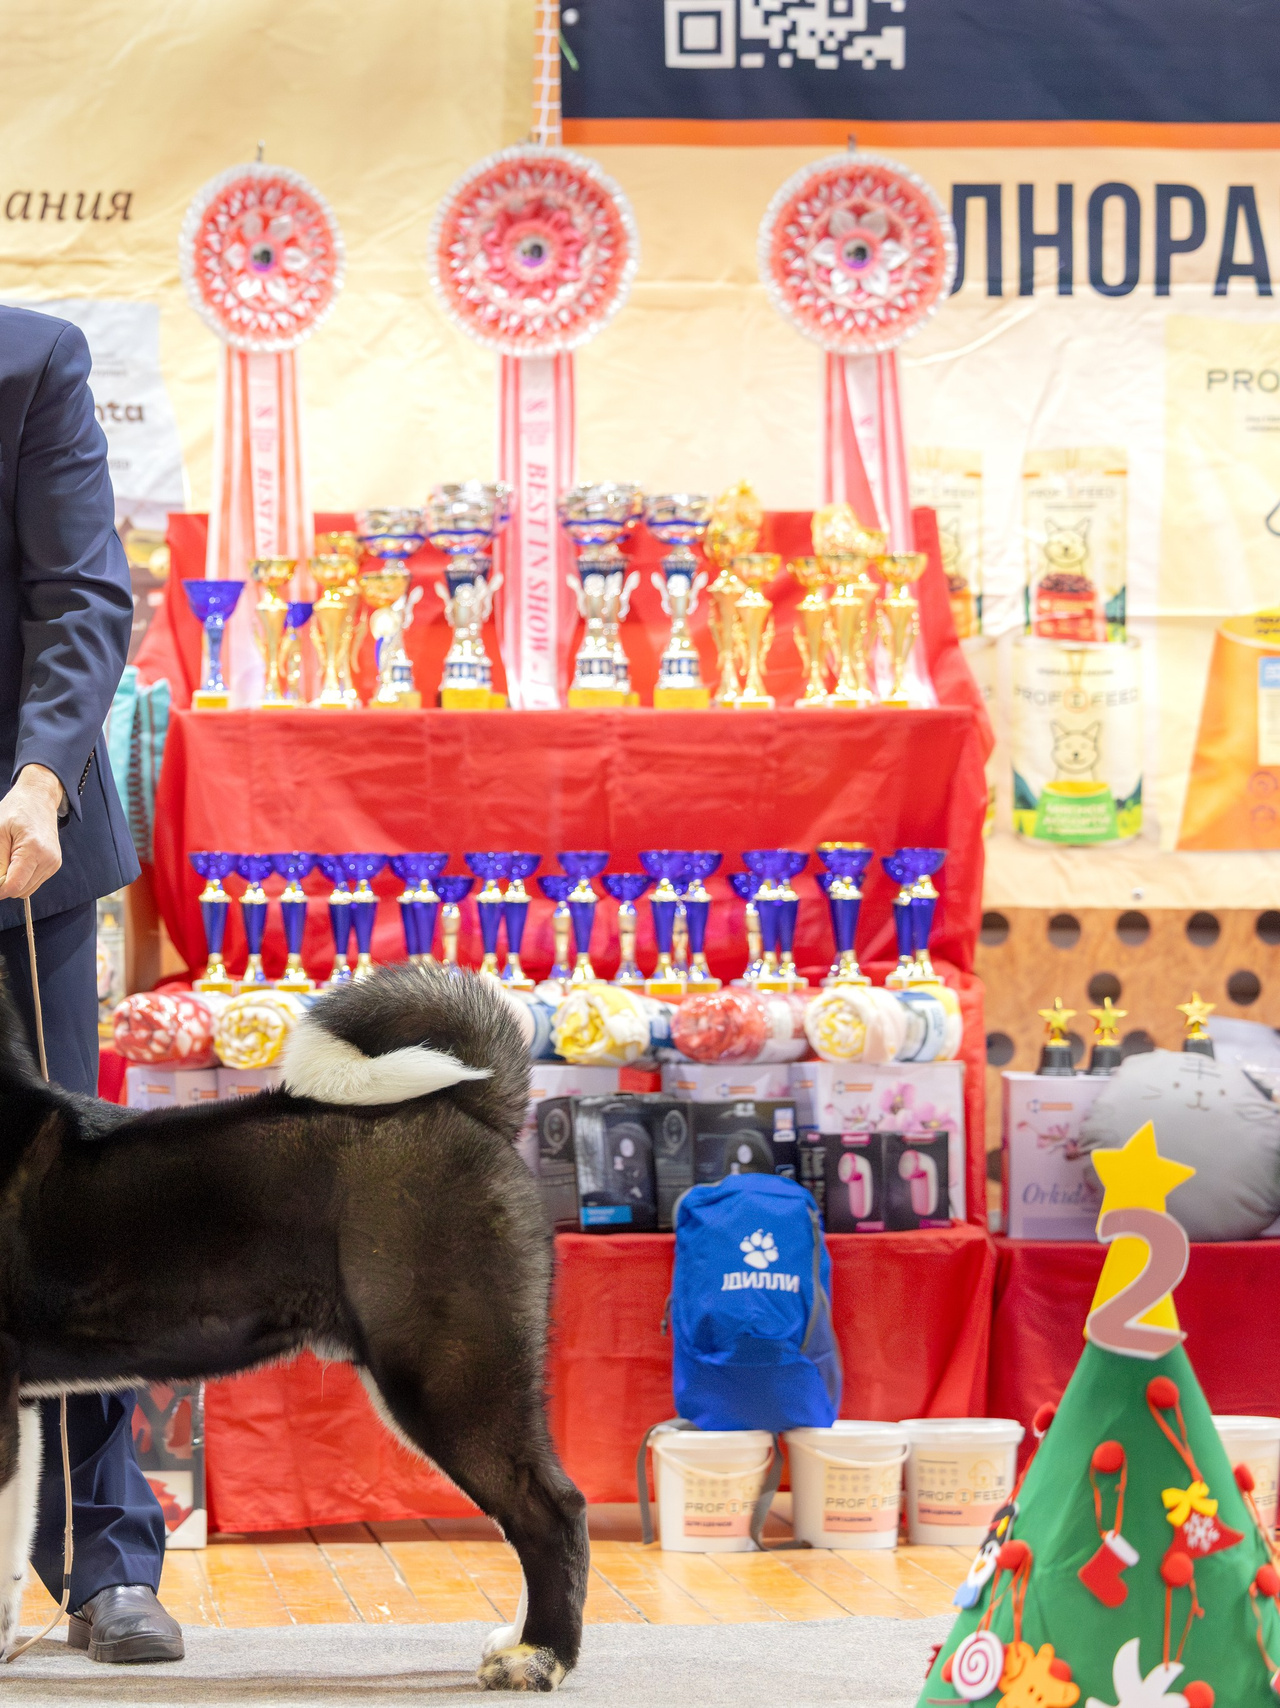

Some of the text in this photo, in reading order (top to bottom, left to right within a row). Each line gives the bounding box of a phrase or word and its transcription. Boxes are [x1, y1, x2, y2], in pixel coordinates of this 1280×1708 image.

[525, 462, 550, 535] BEST
[528, 540, 550, 569] IN
[526, 576, 551, 653] SHOW
[1085, 1207, 1190, 1360] 2
